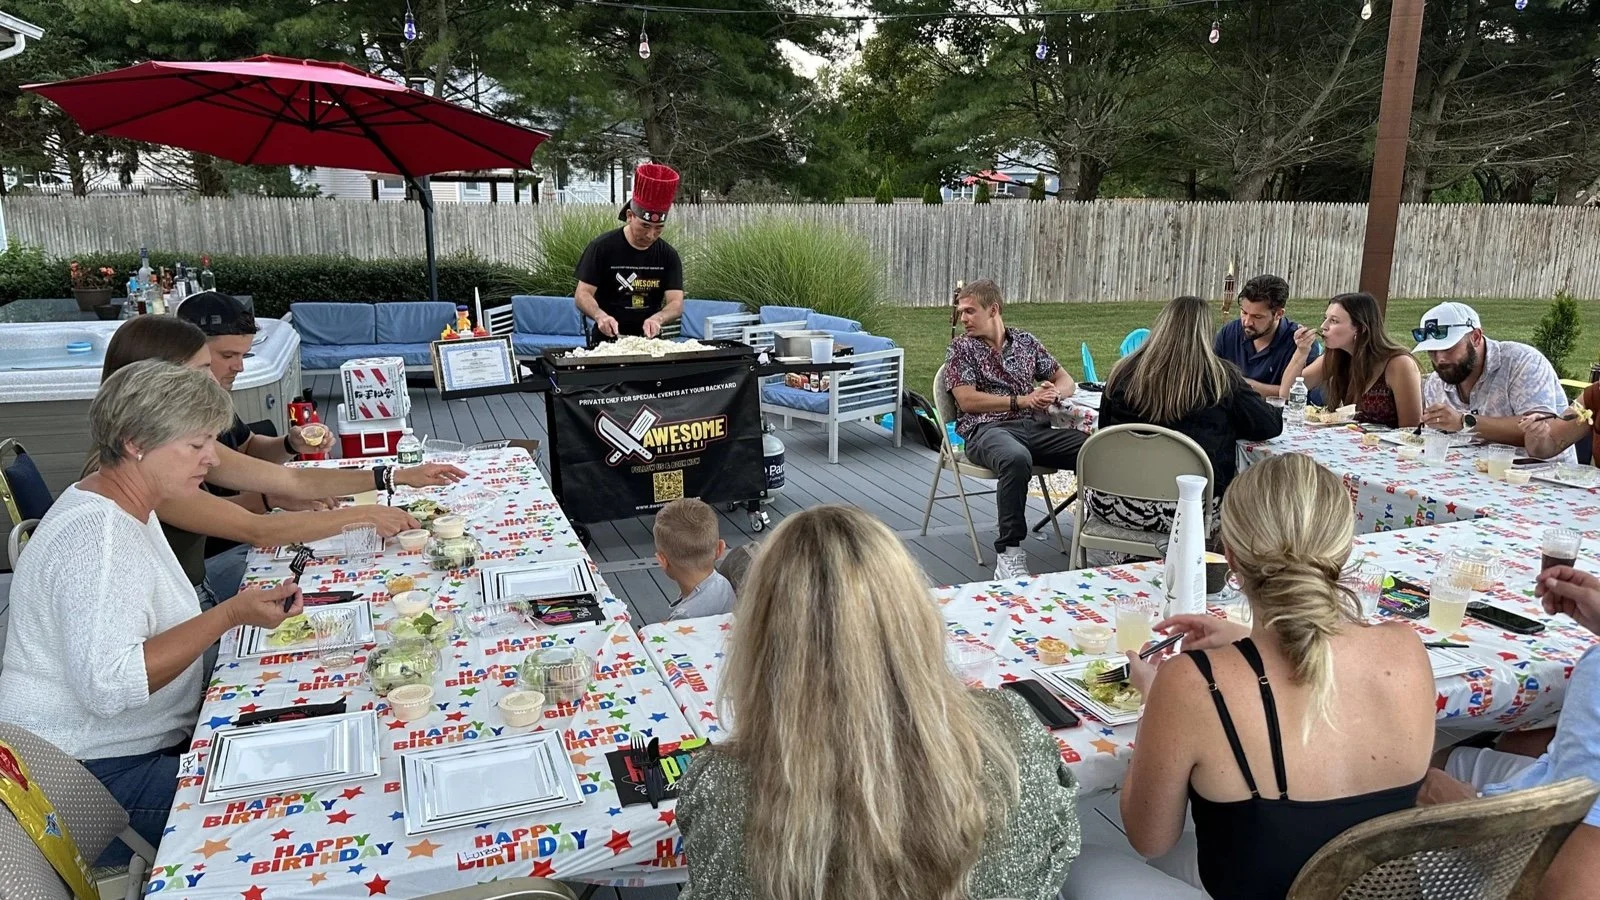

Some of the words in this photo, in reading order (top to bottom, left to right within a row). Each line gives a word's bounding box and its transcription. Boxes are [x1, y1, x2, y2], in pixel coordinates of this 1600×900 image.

[579, 398, 605, 406] PRIVATE
[658, 390, 680, 398] EVENTS
[690, 386, 705, 394] YOUR
[706, 382, 736, 392] BACKYARD
[642, 418, 724, 448] AWESOME
[657, 440, 704, 454] HIBACHI
[631, 464, 656, 474] FOLLOW
[770, 464, 784, 476] Par
[485, 637, 576, 656] BIRTHDAY
[497, 634, 558, 646] HAPPY
[445, 671, 518, 688] BIRTHD
[394, 726, 504, 750] BIRTHDAY
[410, 720, 484, 740] HAPPY
[202, 798, 338, 828] BIRTHDAY
[226, 792, 317, 814] HAPPY
[274, 833, 371, 859] HAPPY
[474, 823, 562, 848] HAPPY
[250, 841, 394, 876] BIRTHDAY
